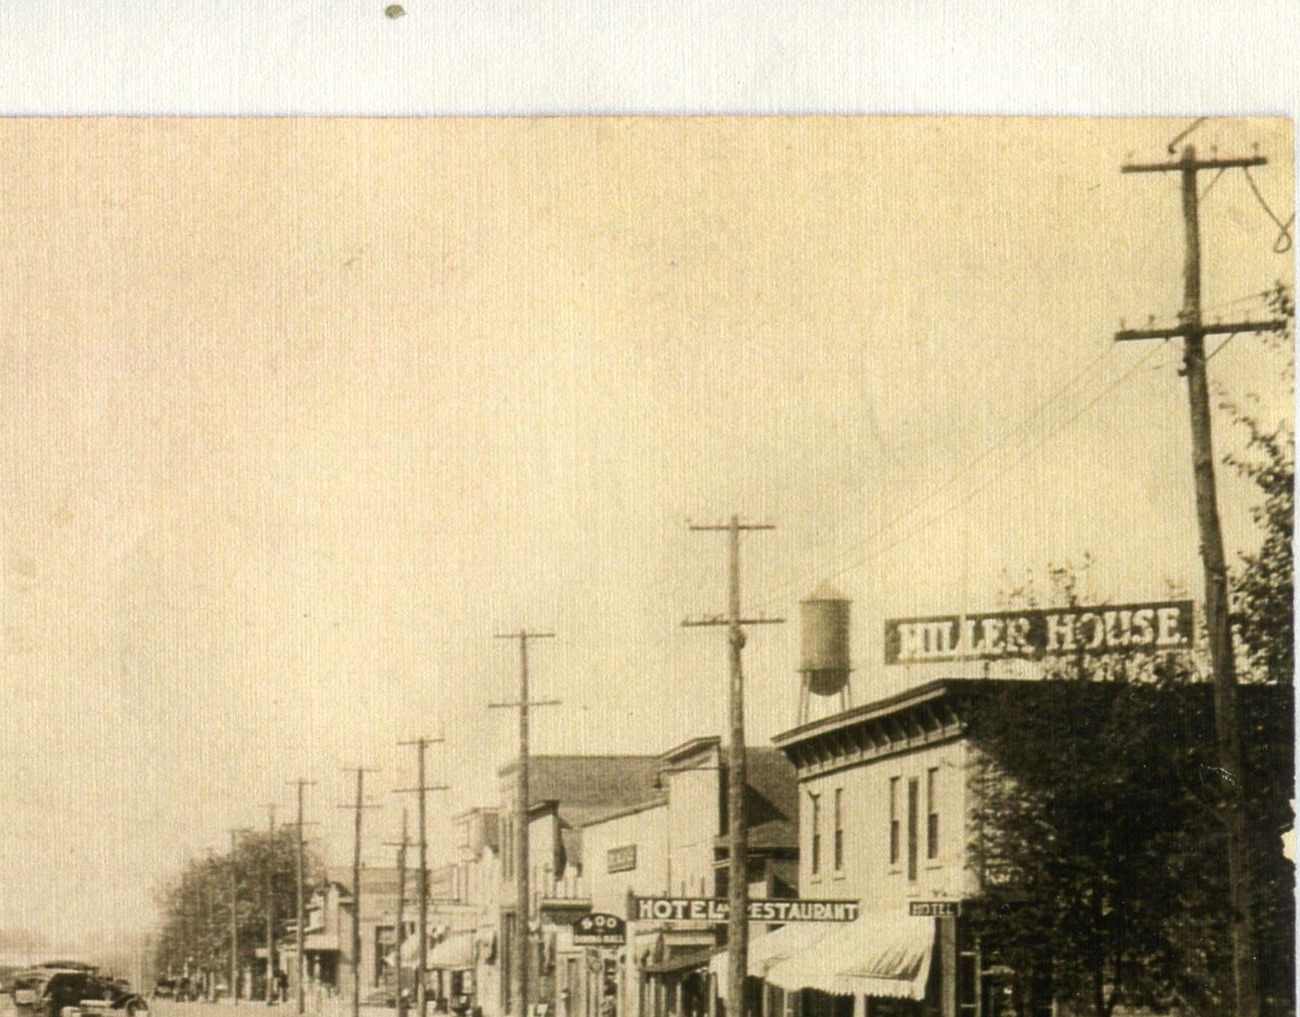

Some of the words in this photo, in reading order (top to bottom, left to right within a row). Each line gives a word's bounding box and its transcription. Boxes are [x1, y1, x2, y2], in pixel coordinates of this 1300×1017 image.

[897, 617, 1035, 657] MILLER
[639, 899, 725, 919] HOTEL
[747, 902, 858, 920] ESTAURANT
[912, 903, 954, 915] HOTEL
